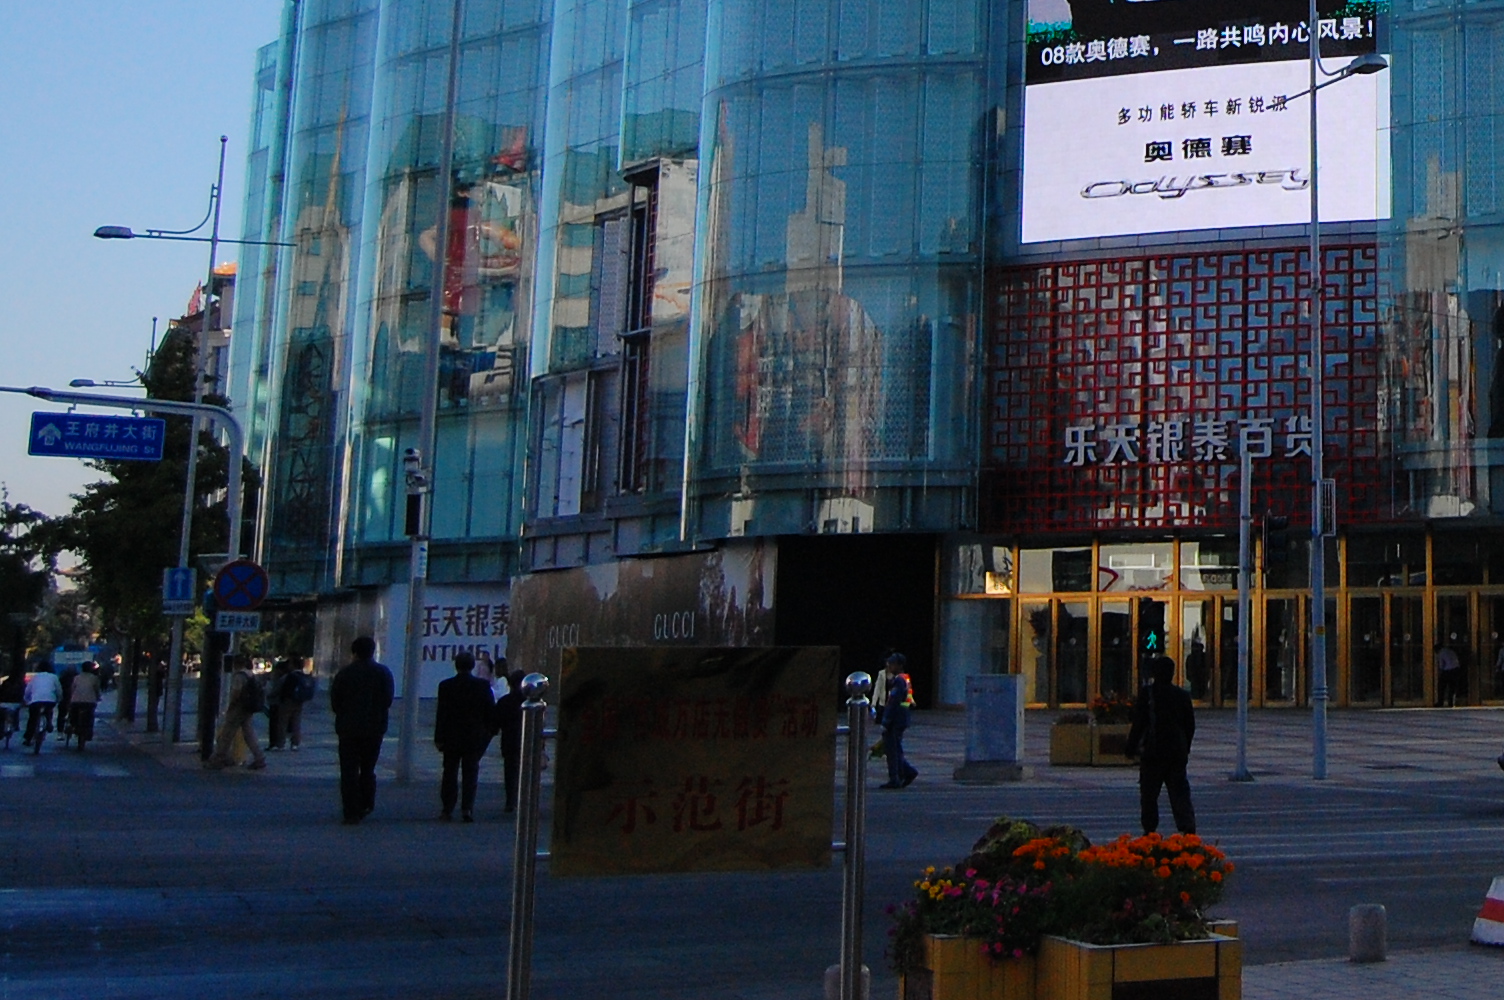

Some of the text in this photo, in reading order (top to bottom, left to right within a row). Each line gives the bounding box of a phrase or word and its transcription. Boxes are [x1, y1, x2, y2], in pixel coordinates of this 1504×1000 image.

[1144, 134, 1253, 163] 奥德赛
[65, 421, 157, 441] 王府井大街
[1064, 414, 1323, 467] 乐天银泰百货
[64, 441, 138, 454] WANGFUJING
[550, 623, 580, 648] GUCCI
[654, 611, 696, 640] GUCCI
[605, 775, 790, 834] 示范街
